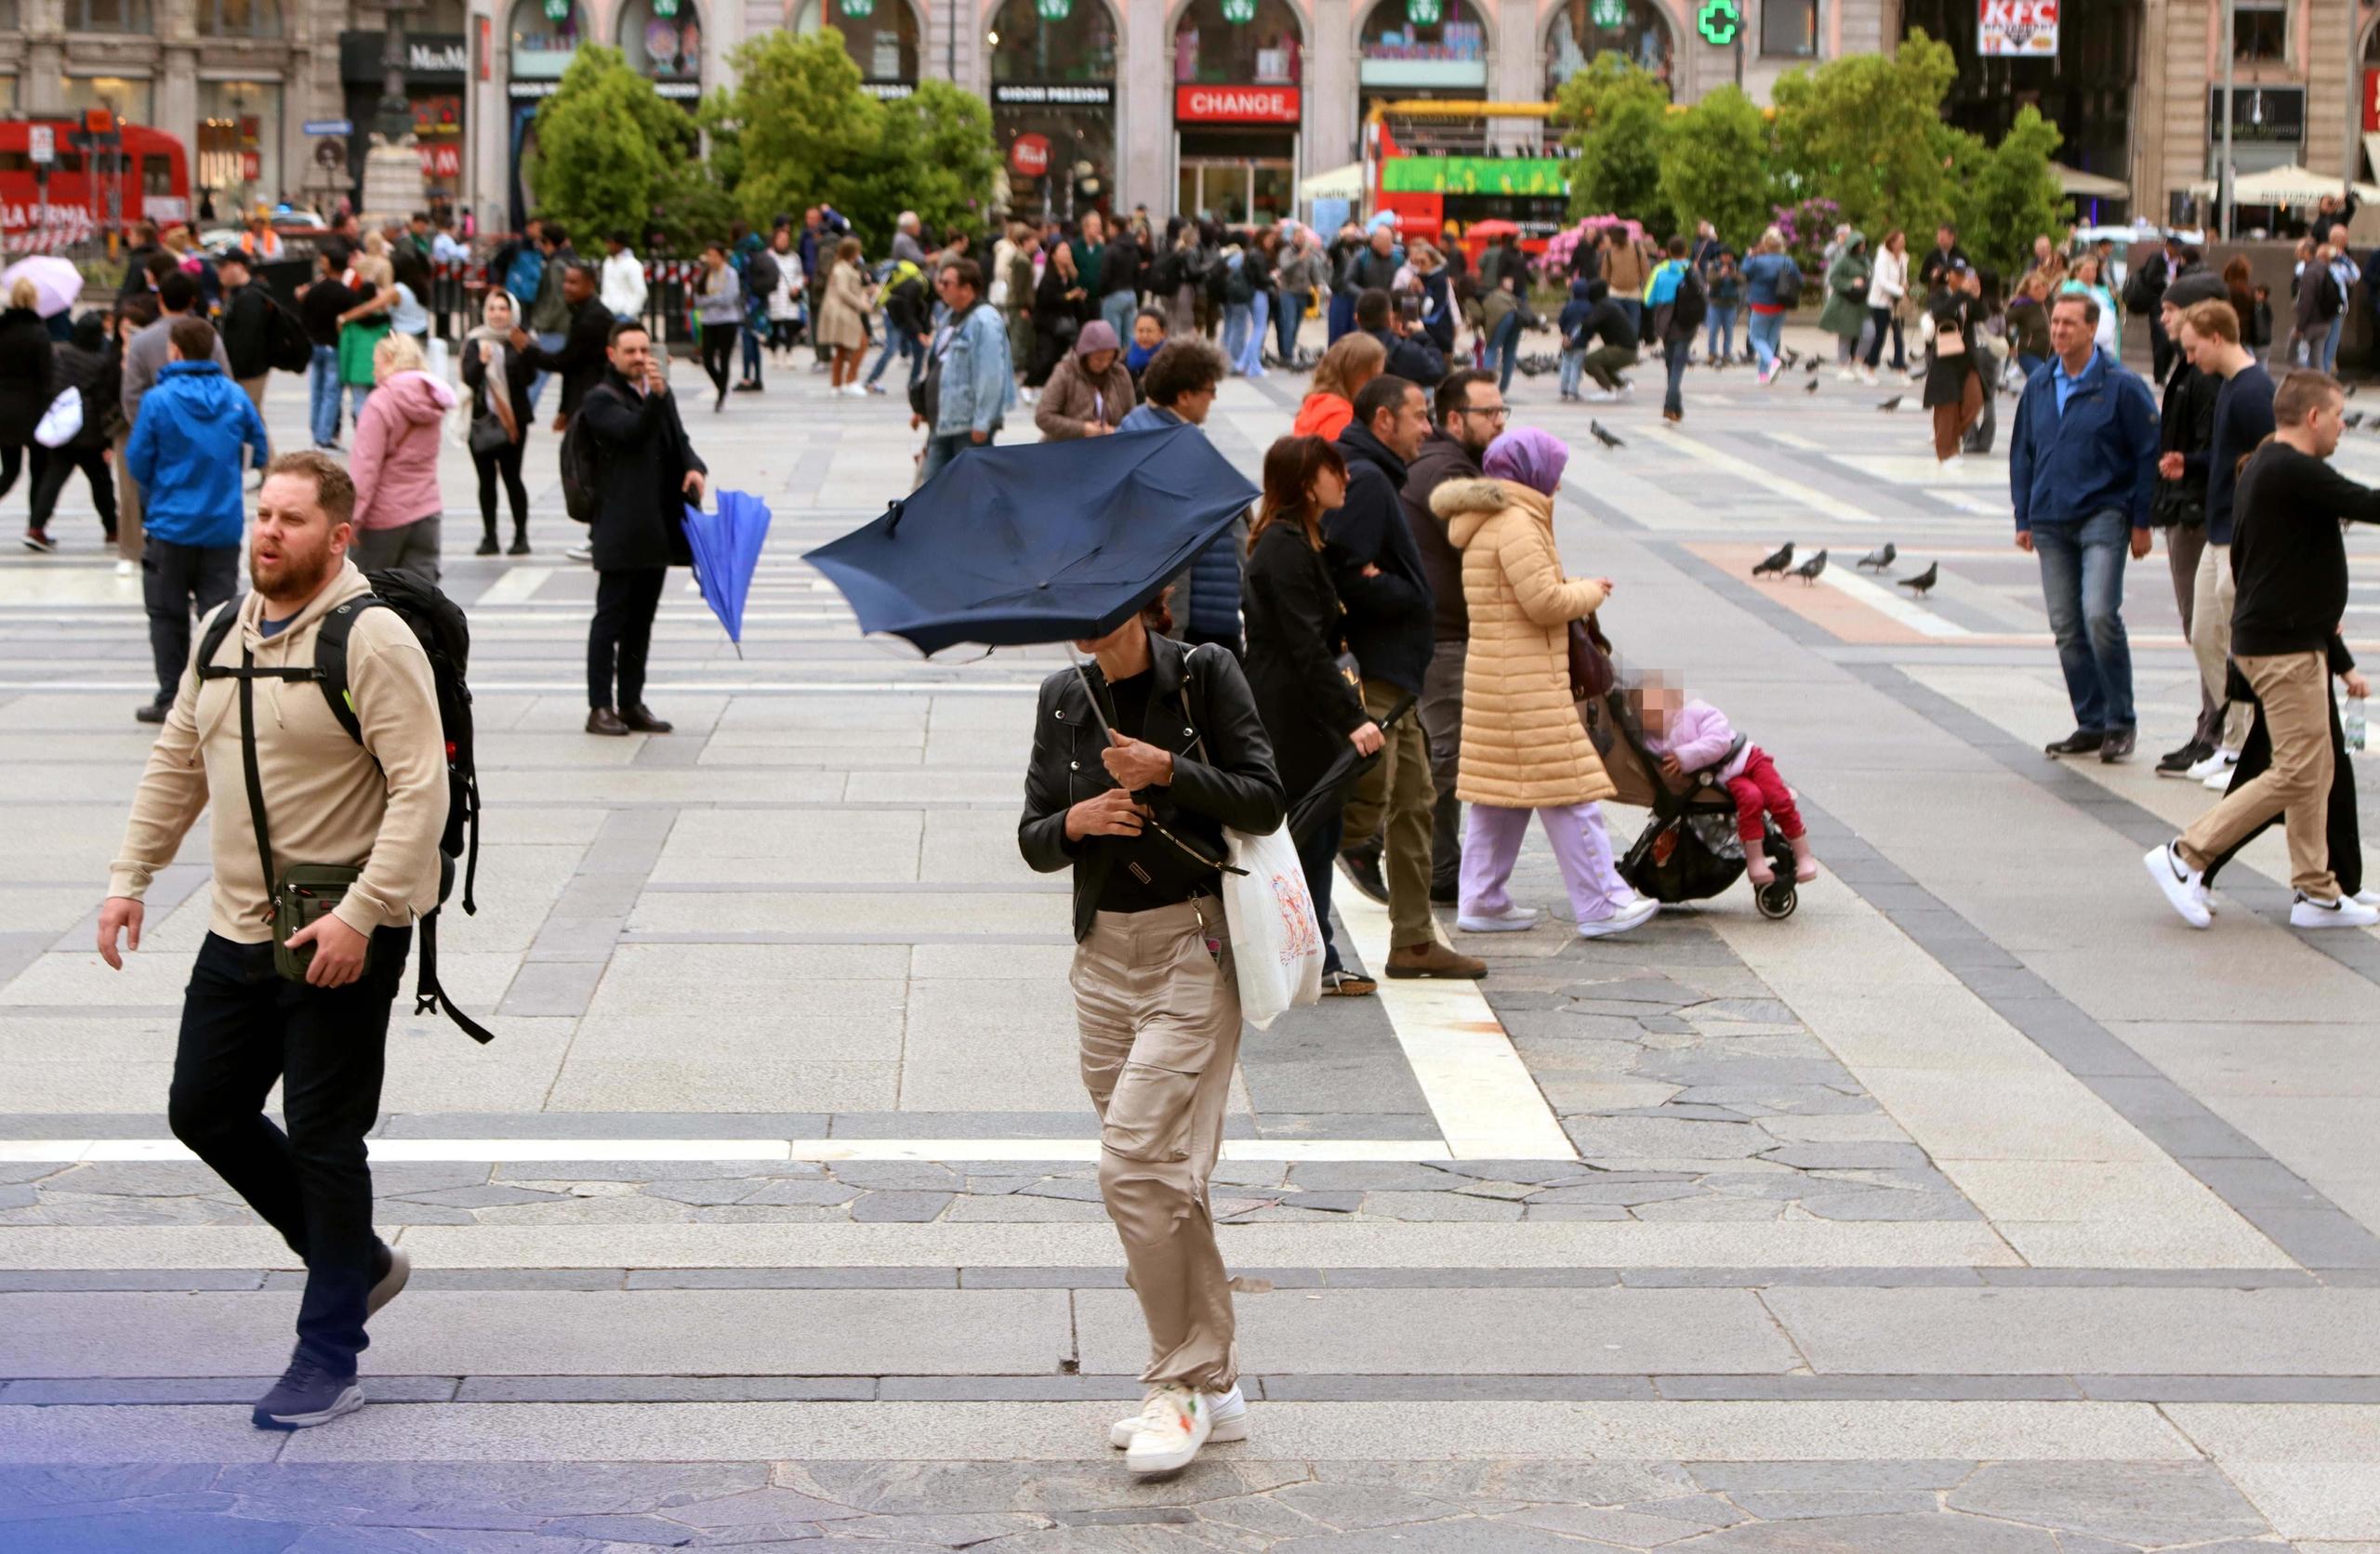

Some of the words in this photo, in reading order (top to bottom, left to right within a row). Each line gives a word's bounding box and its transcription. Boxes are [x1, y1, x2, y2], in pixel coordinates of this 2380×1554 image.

[1981, 0, 2056, 24] KFC
[998, 86, 1046, 101] GIOCHI
[1047, 86, 1109, 102] PREZIOSI
[1191, 92, 1285, 115] CHANGE
